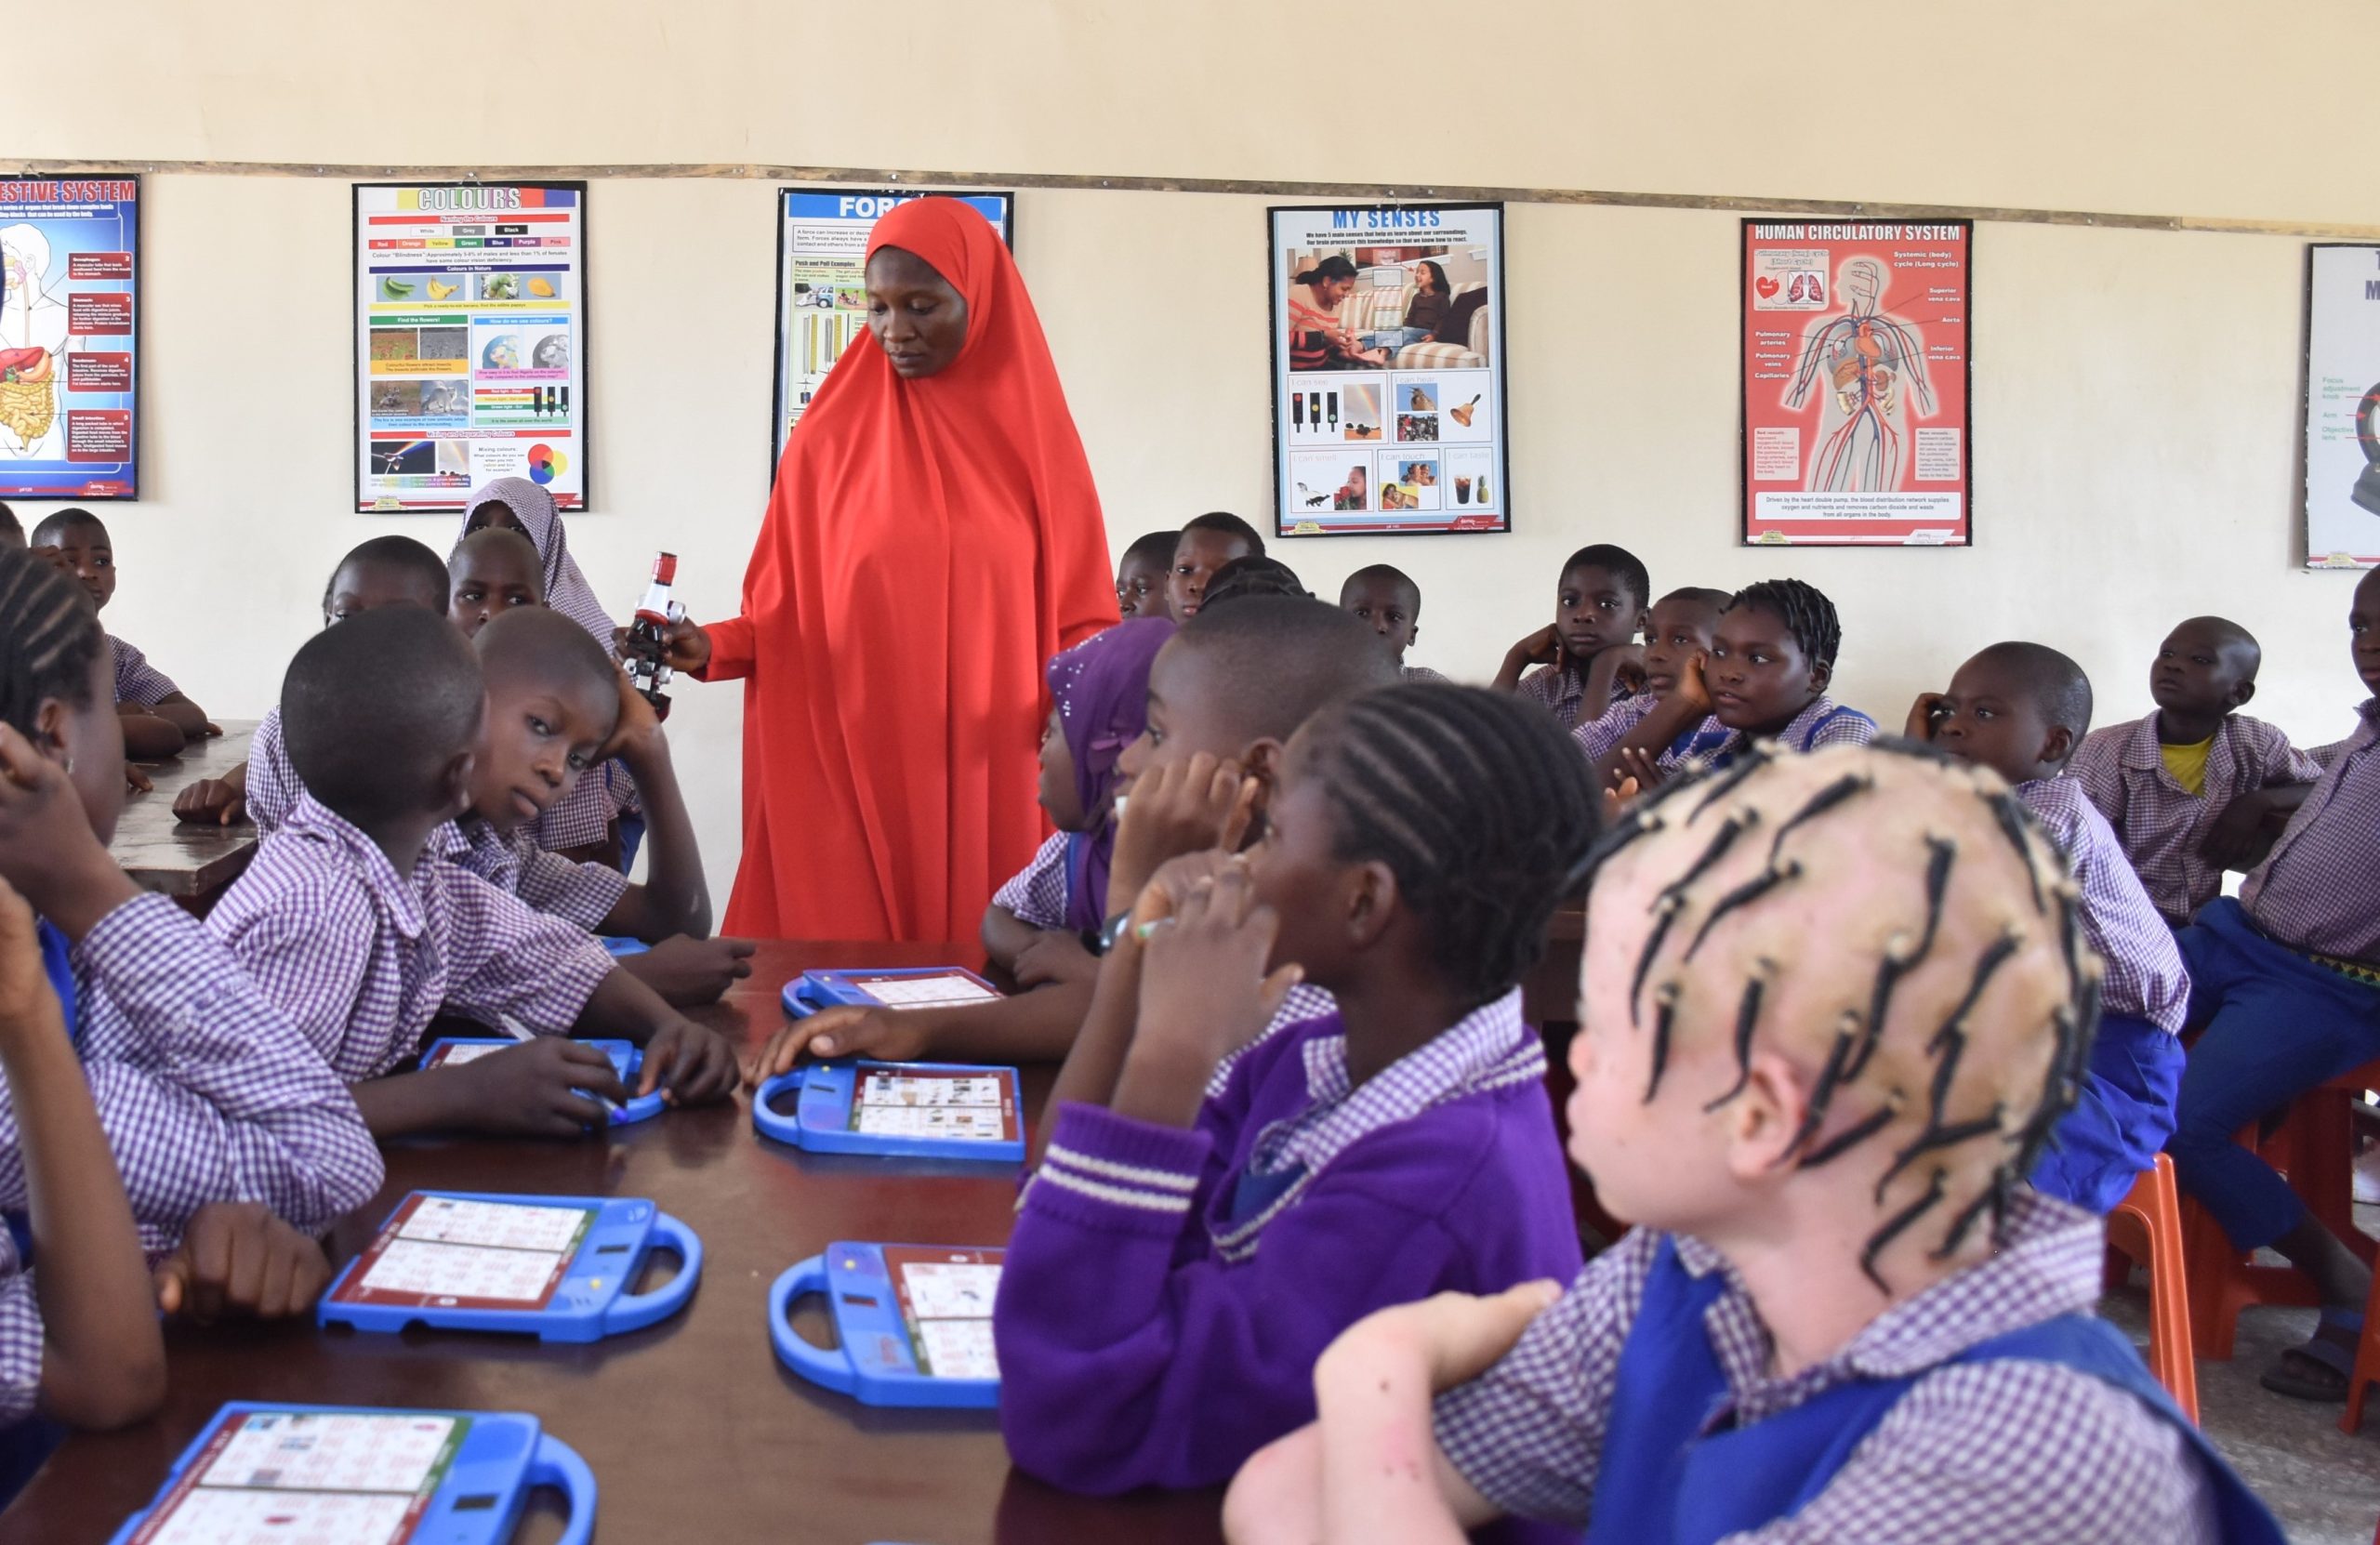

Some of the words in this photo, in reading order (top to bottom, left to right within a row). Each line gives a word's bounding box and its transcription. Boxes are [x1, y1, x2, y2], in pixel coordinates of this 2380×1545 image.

[61, 179, 136, 202] SYSTEM
[417, 188, 522, 210] COLOURS
[840, 197, 912, 218] FOR
[1332, 211, 1360, 229] MY
[1367, 210, 1440, 228] SENSES
[1755, 225, 1805, 240] HUMAN
[1807, 225, 1902, 240] CIRCULATORY
[1904, 225, 1960, 240] SYSTEM
